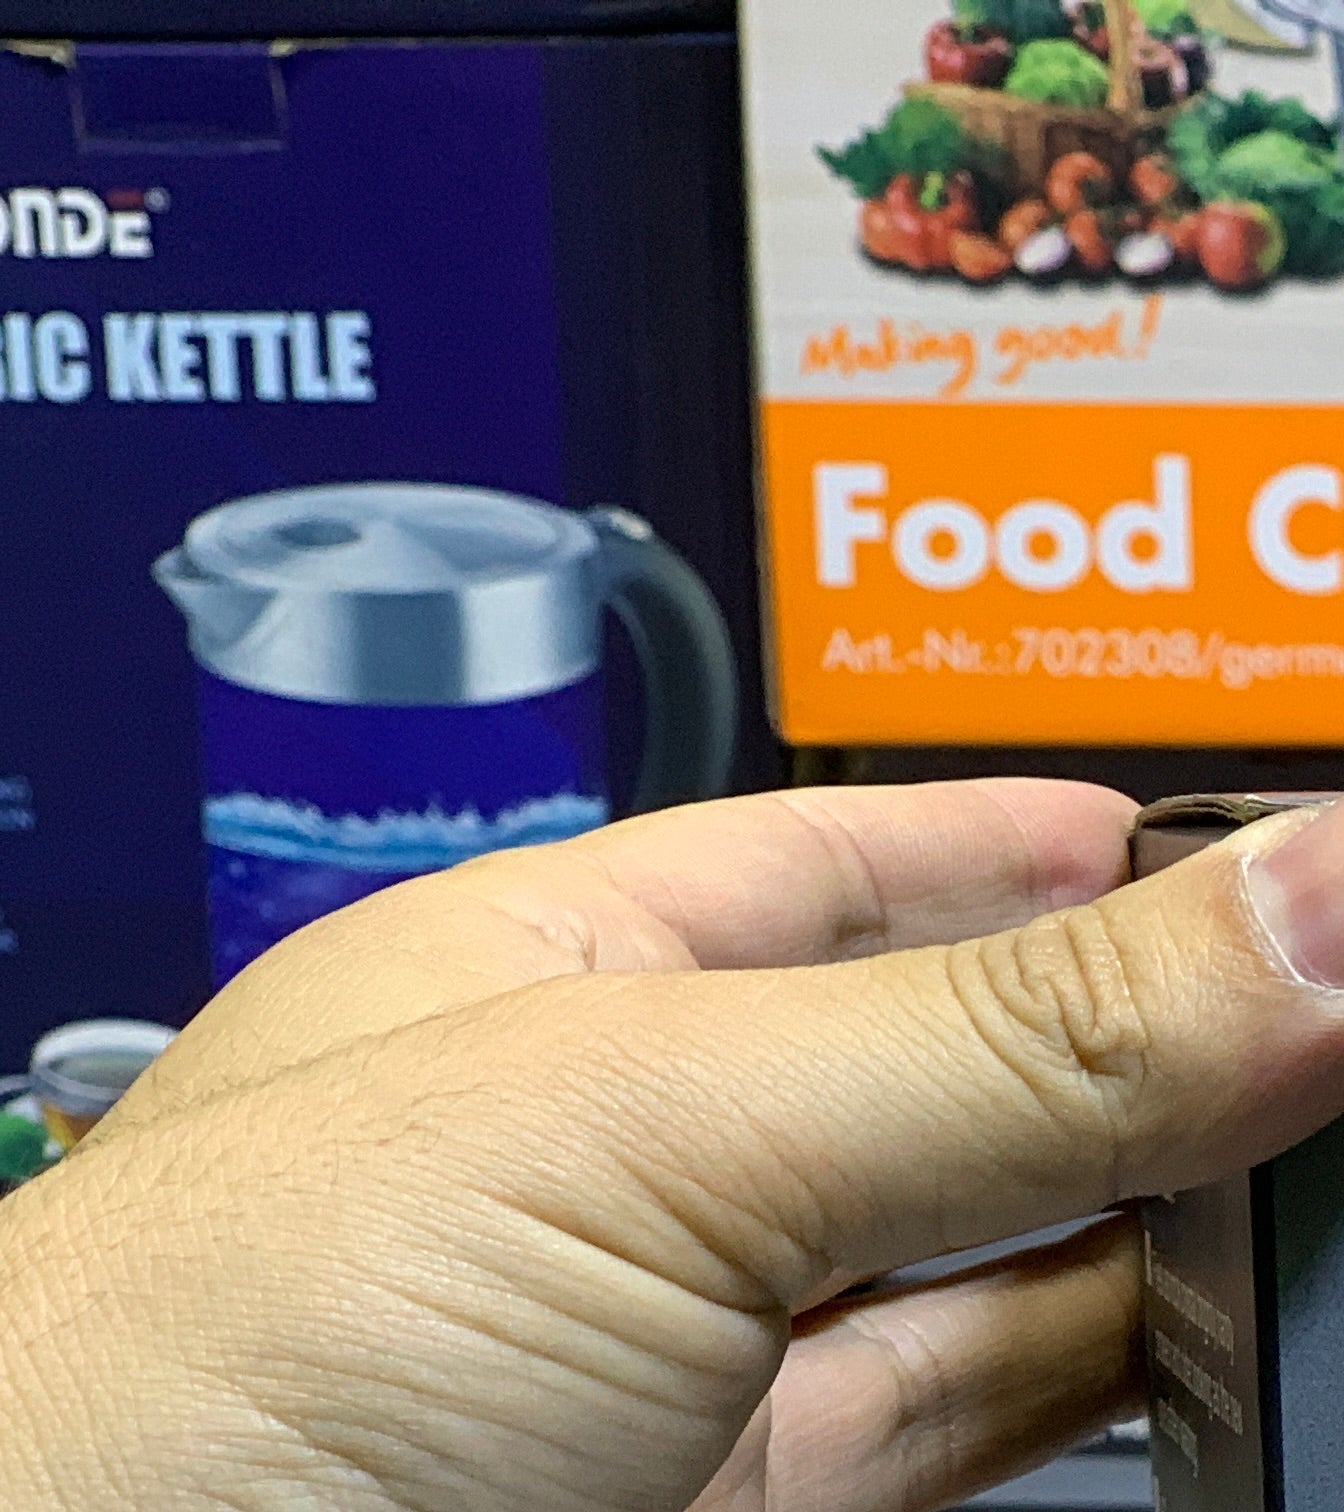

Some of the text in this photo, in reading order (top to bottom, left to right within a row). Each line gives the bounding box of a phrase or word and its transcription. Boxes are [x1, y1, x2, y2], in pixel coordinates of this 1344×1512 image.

[0, 311, 377, 402] IC KETTLE
[800, 293, 1163, 398] Making good!
[813, 455, 1193, 592] Food
